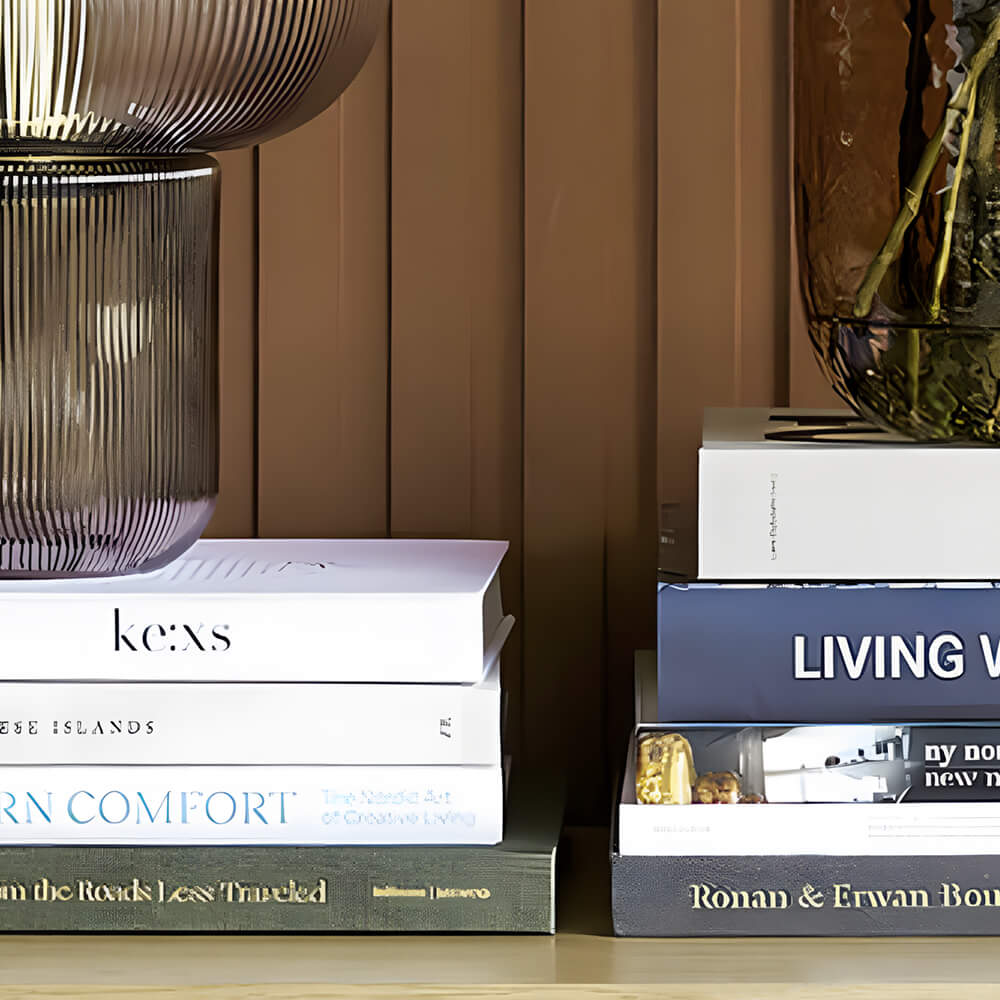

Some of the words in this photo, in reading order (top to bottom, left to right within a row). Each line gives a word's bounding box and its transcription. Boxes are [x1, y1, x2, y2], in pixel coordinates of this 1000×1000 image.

[794, 634, 965, 680] LIVING
[52, 720, 155, 735] ISLANDS
[925, 771, 978, 787] new
[67, 790, 298, 825] COMFORT
[690, 884, 788, 910] Ronan
[798, 883, 824, 909] &
[833, 883, 930, 909] Erwan
